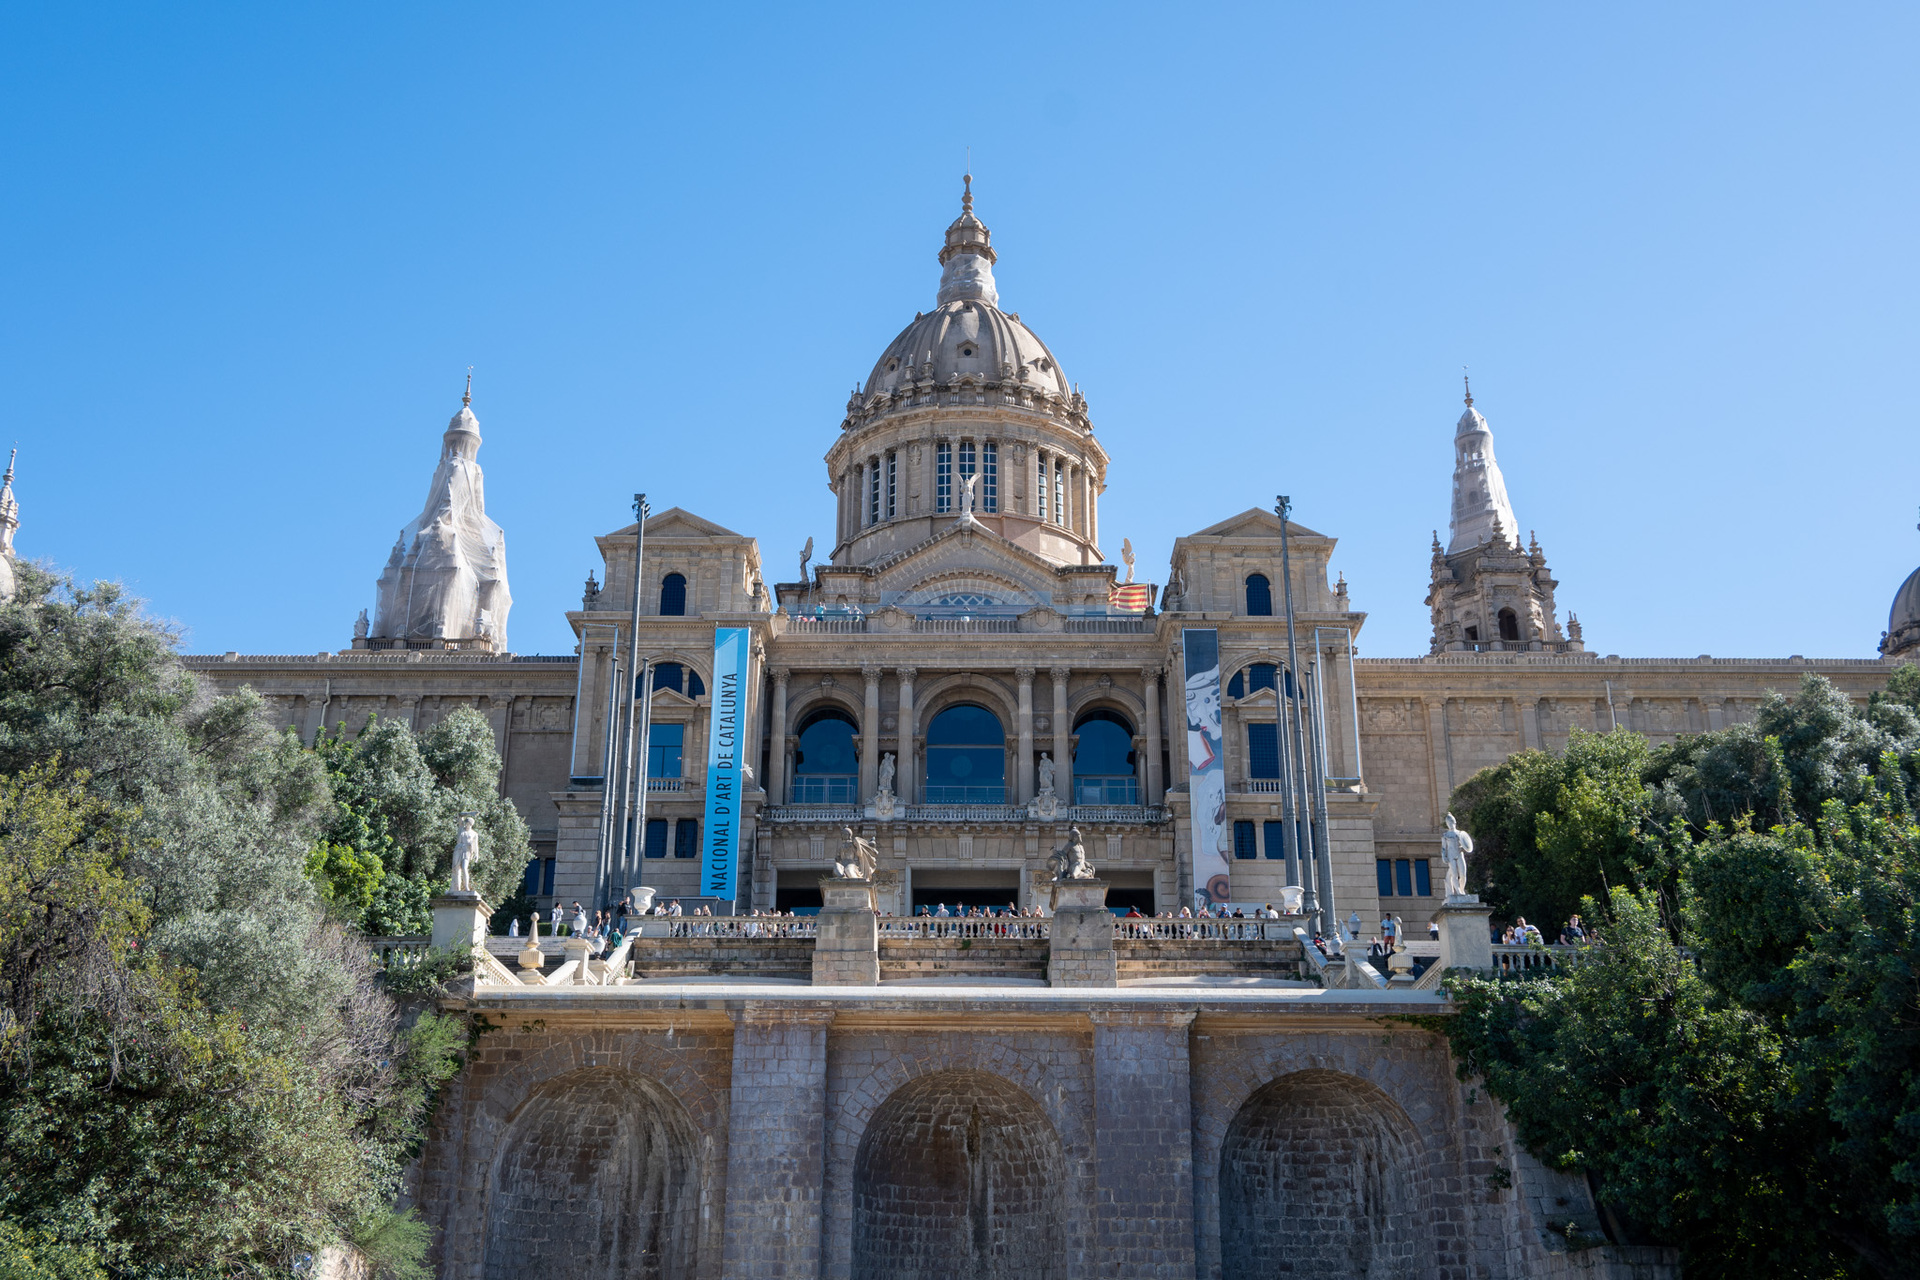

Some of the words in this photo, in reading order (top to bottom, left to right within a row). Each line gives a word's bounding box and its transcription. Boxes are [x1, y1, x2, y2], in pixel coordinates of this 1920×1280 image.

[718, 673, 738, 747] CATALUNYA
[717, 753, 734, 769] DE
[714, 775, 732, 815] D'ART
[710, 821, 730, 891] NACIONAL
